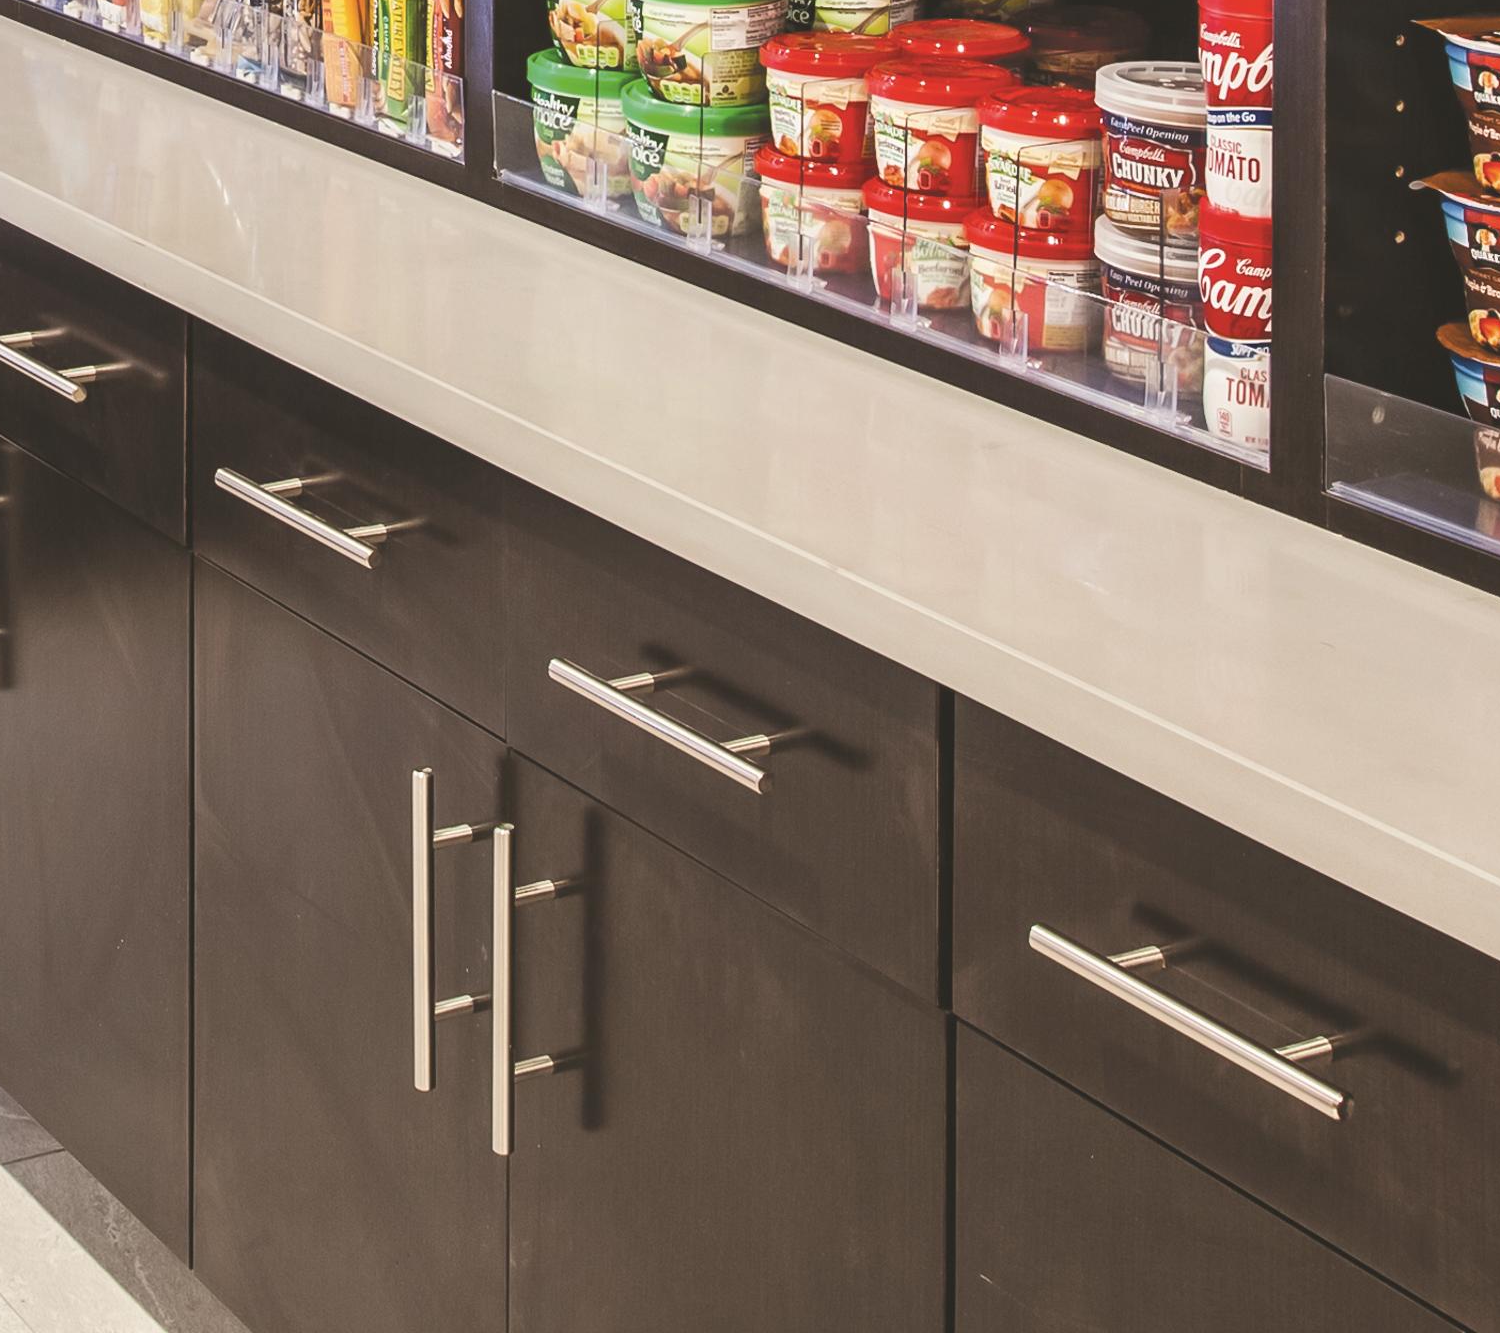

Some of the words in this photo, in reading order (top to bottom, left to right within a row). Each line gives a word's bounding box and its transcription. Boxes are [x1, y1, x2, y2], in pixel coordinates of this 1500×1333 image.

[533, 91, 575, 115] Healthy
[1128, 123, 1144, 134] Peel
[1146, 128, 1189, 143] Opening
[1119, 141, 1165, 162] Campbell's
[1112, 157, 1184, 188] CHUNKY
